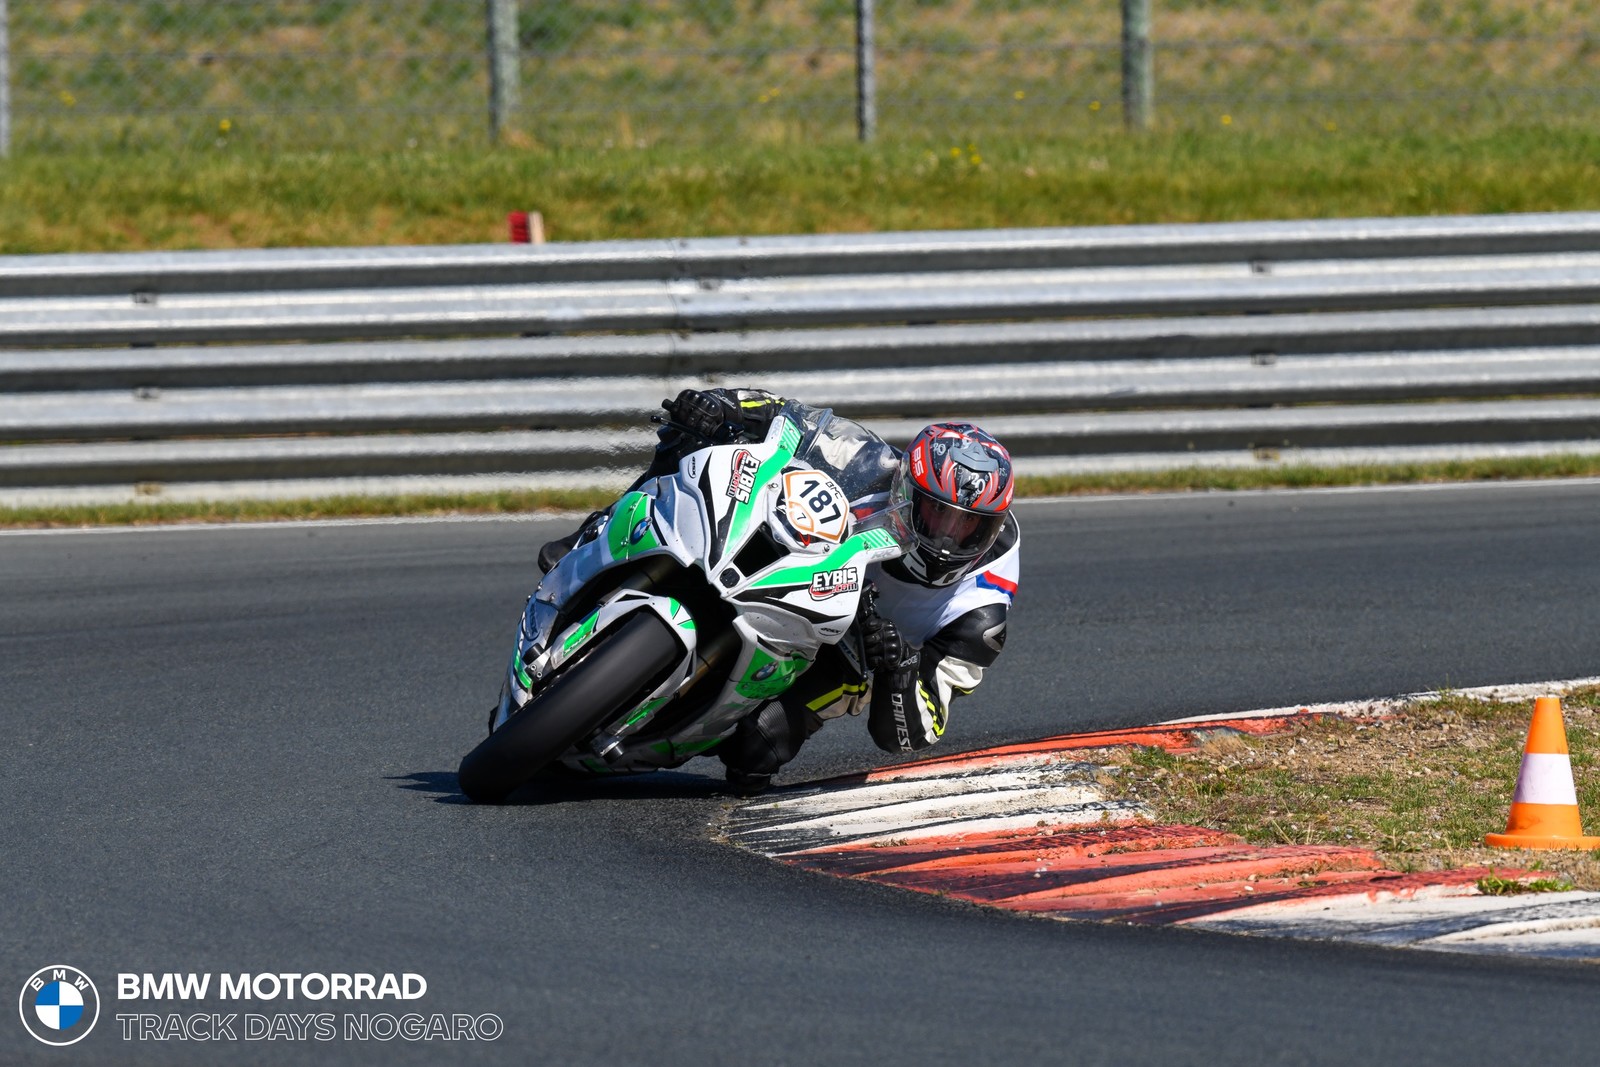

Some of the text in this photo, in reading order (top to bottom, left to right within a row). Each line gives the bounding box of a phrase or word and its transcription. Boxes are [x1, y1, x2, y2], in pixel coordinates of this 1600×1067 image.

[735, 455, 760, 504] EYBIS
[799, 480, 841, 524] 187
[812, 567, 857, 588] EYBIS
